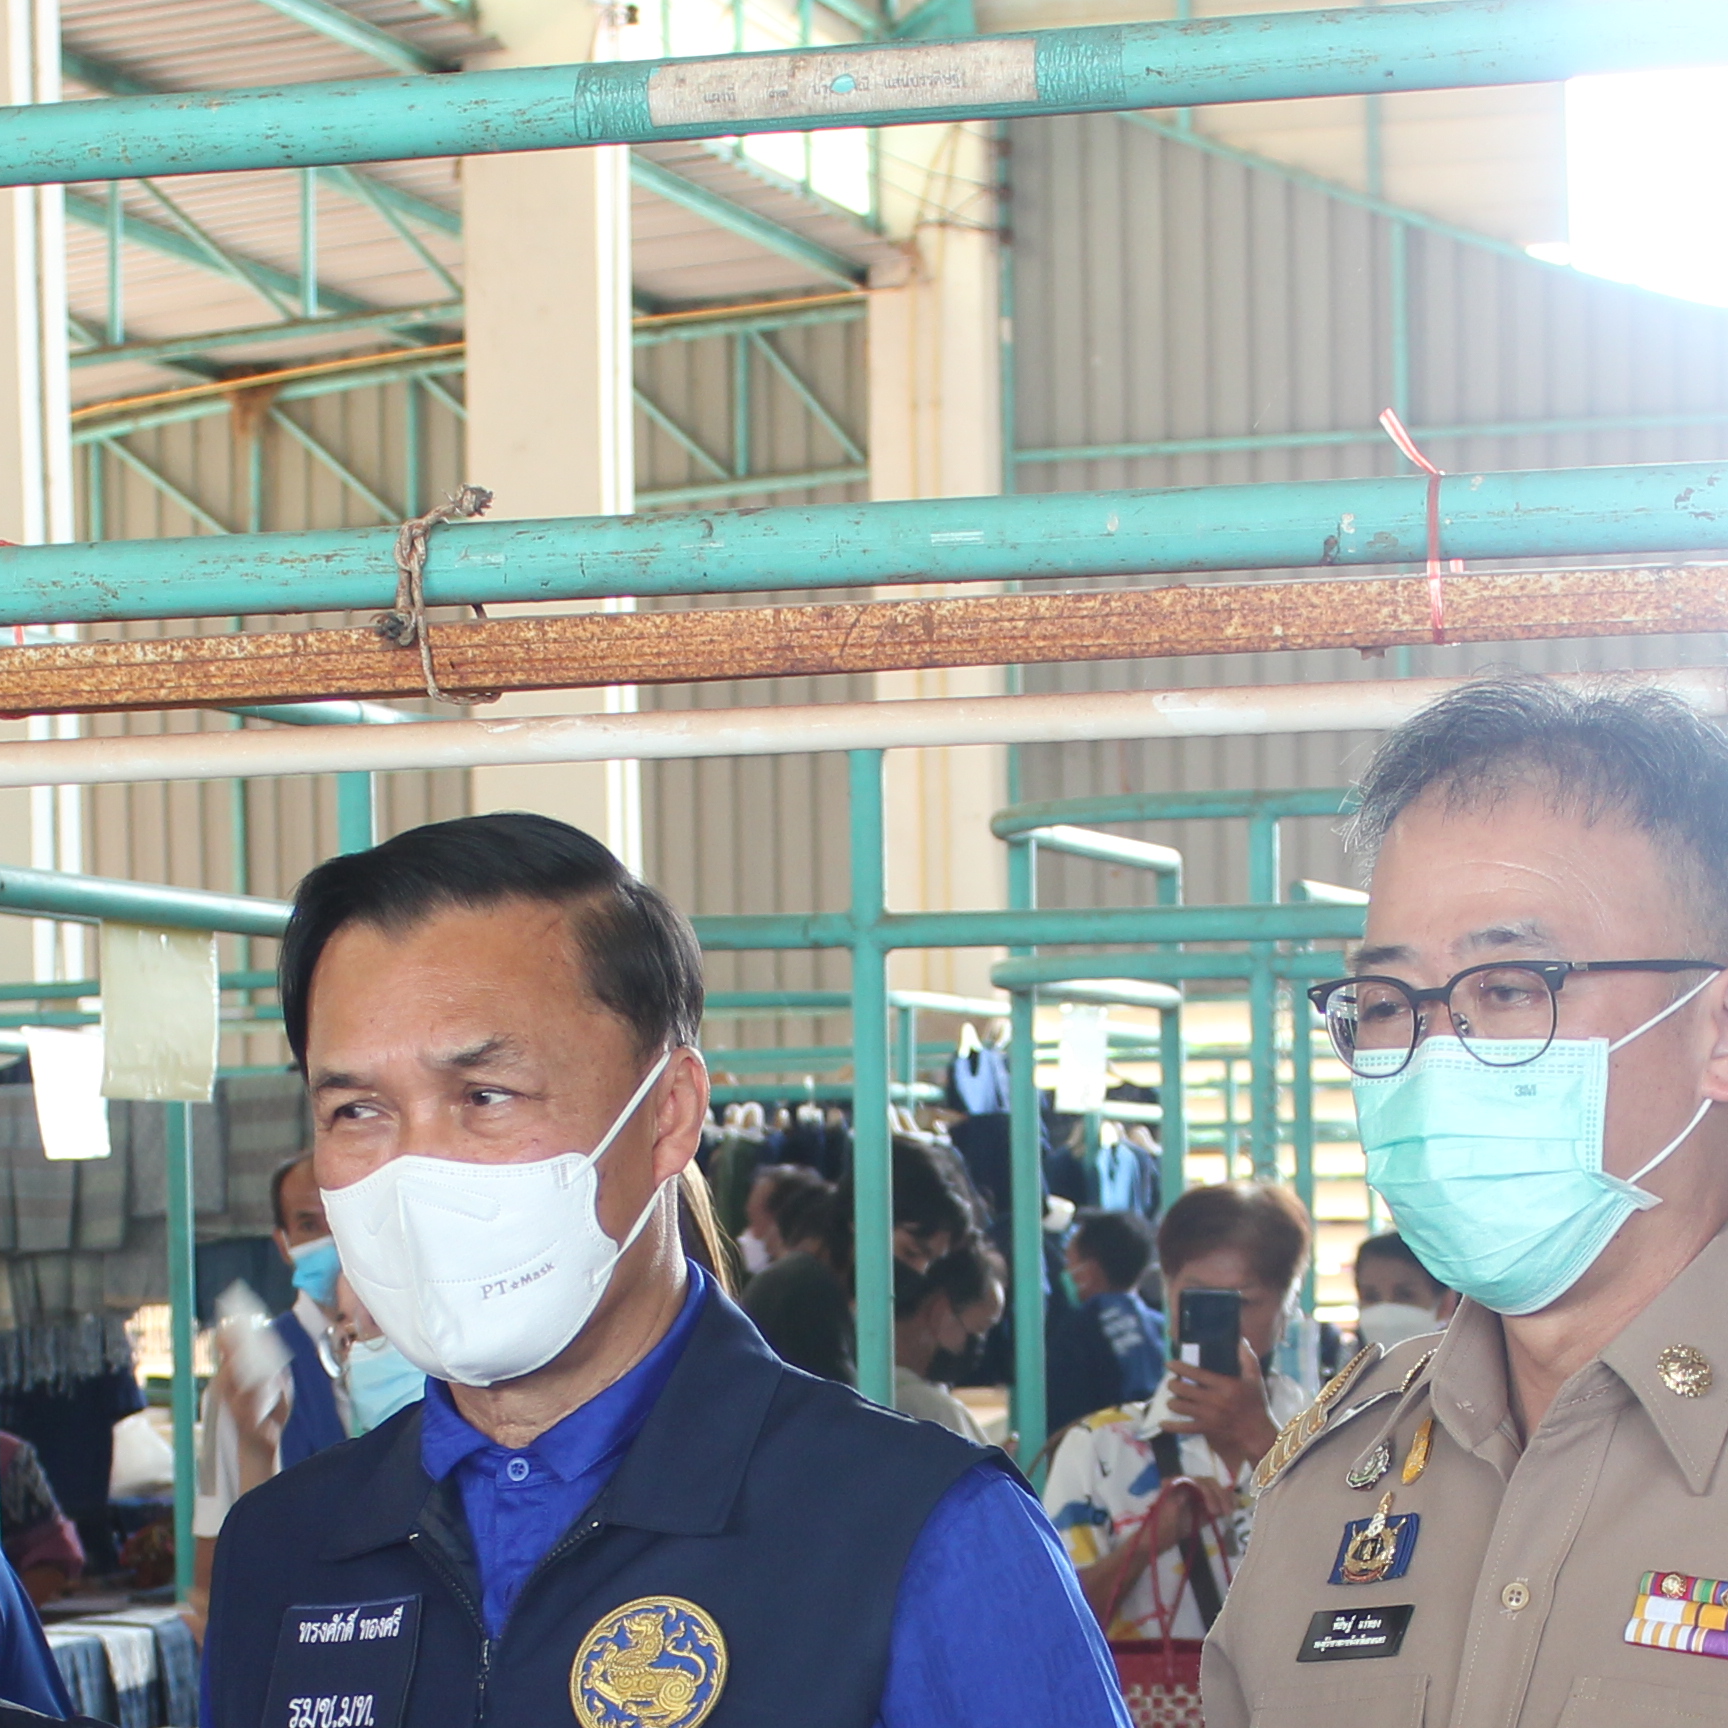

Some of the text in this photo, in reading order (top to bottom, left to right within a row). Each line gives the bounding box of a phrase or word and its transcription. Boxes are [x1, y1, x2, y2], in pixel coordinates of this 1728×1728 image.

[480, 1261, 555, 1300] PT Mask
[288, 1694, 376, 1728] รมช.มท.
